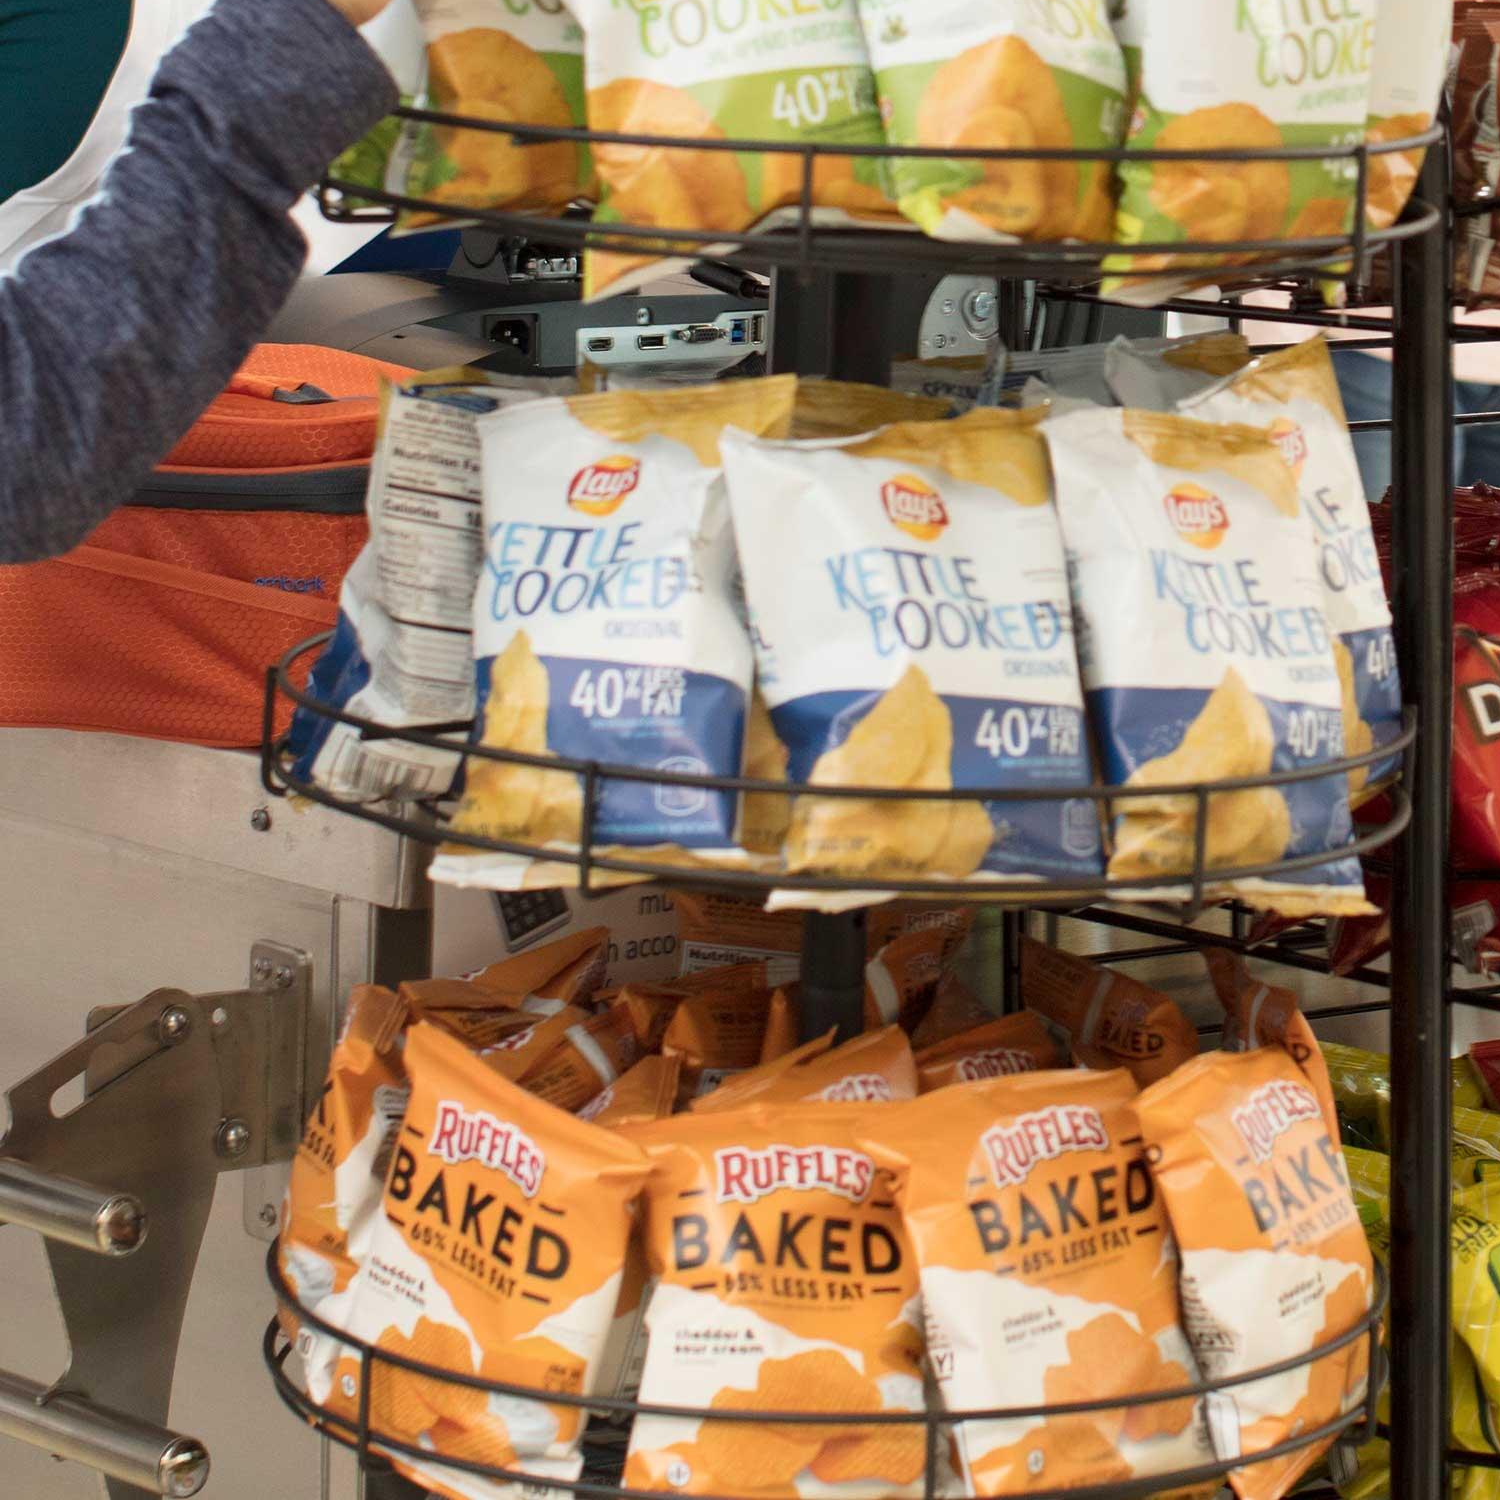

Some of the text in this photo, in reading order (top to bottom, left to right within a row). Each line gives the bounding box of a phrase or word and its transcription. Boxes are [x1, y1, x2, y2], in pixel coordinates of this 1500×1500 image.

[393, 447, 458, 468] Nutrition
[569, 462, 642, 501] Lay's
[382, 499, 440, 520] Calories
[491, 555, 689, 622] COOKED
[826, 548, 987, 613] KETTLE
[869, 599, 1060, 659] COOKED
[1185, 604, 1329, 660] COOKED
[569, 667, 641, 718] 40%
[640, 687, 686, 716] FAT
[974, 706, 1048, 758] 40%
[689, 949, 761, 966] Nutrition
[434, 1106, 541, 1192] RUFFLES
[985, 1107, 1105, 1183] RUFFLES
[1235, 1083, 1319, 1160] RUFFLES
[721, 1148, 873, 1200] RUFFLES
[389, 1146, 572, 1281] BAKED
[969, 1159, 1155, 1255] BAKED
[451, 1242, 485, 1279] LESS
[488, 1267, 517, 1299] FAT
[672, 1211, 900, 1276] BAKED
[1061, 1237, 1098, 1264] LESS
[1101, 1226, 1131, 1251] FAT
[772, 1276, 819, 1299] LESS
[826, 1281, 864, 1300] FAT
